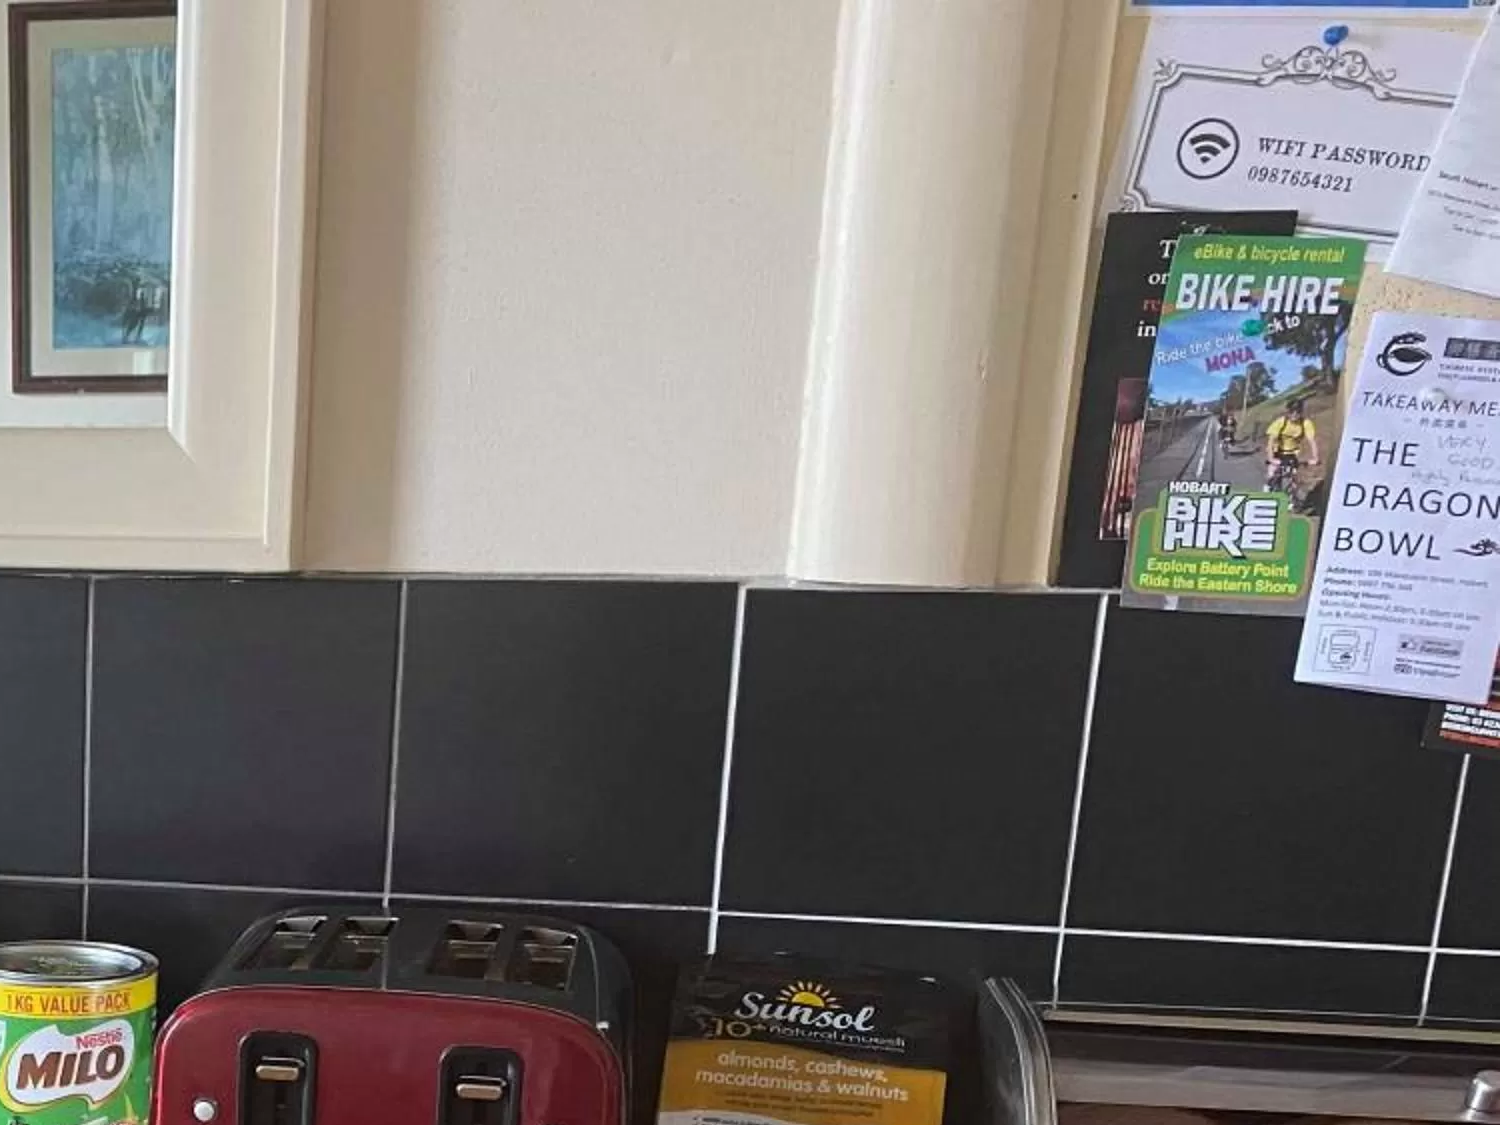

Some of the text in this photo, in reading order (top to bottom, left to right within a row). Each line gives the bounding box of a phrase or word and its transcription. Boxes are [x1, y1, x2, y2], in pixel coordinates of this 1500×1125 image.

[1259, 137, 1431, 172] WIFI PASSWORD
[1248, 166, 1353, 192] 0987654321
[1194, 243, 1345, 265] eBike & bicycle rental
[1176, 273, 1345, 315] BIKE HIRE
[1363, 391, 1464, 415] TAKEAWAY
[1352, 437, 1420, 467] THE
[1169, 481, 1229, 494] HOBART
[1343, 483, 1500, 519] DRAGON
[1165, 494, 1279, 525] BIKE
[1162, 520, 1276, 559] HIRE
[1333, 527, 1441, 560] BOWL
[1139, 573, 1297, 593] Ride the Eastern Shore
[1147, 558, 1289, 579] Explore Battery Point
[39, 994, 89, 1013] VALUE
[95, 991, 132, 1013] PACK
[734, 991, 876, 1032] Sunsol
[768, 1023, 838, 1041] natural
[16, 1047, 125, 1090] MILO
[695, 1068, 909, 1102] macadamias & walnuts
